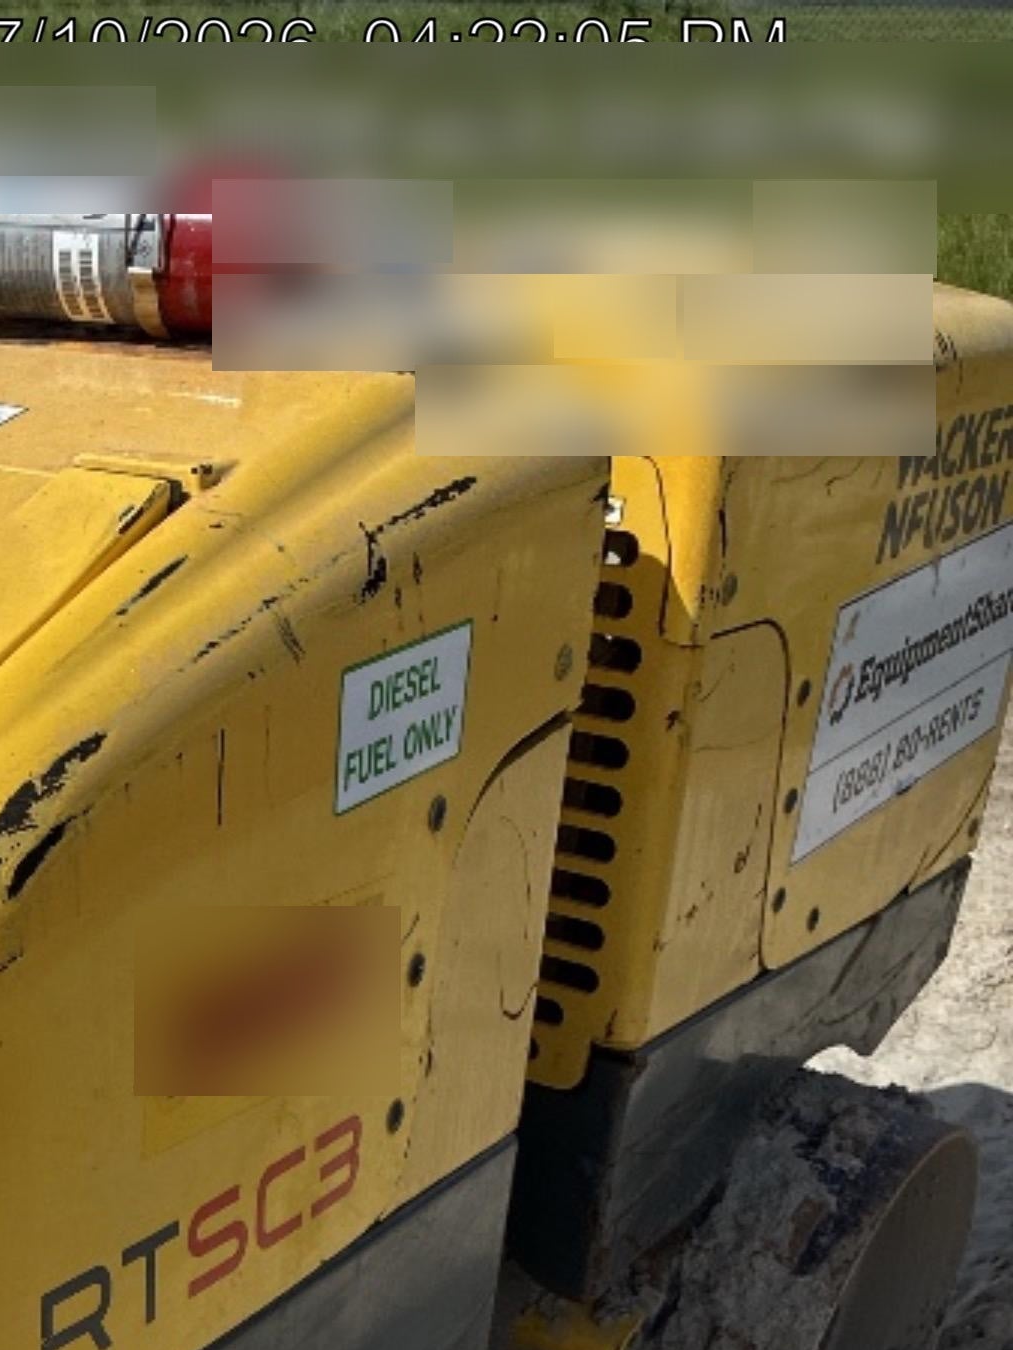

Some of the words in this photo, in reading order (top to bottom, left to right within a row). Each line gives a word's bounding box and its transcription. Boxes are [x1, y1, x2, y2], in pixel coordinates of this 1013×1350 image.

[367, 656, 441, 720] DIESEL
[855, 587, 1013, 703] EquipmentShar
[344, 734, 397, 792] FUEL
[403, 704, 458, 760] ONLY
